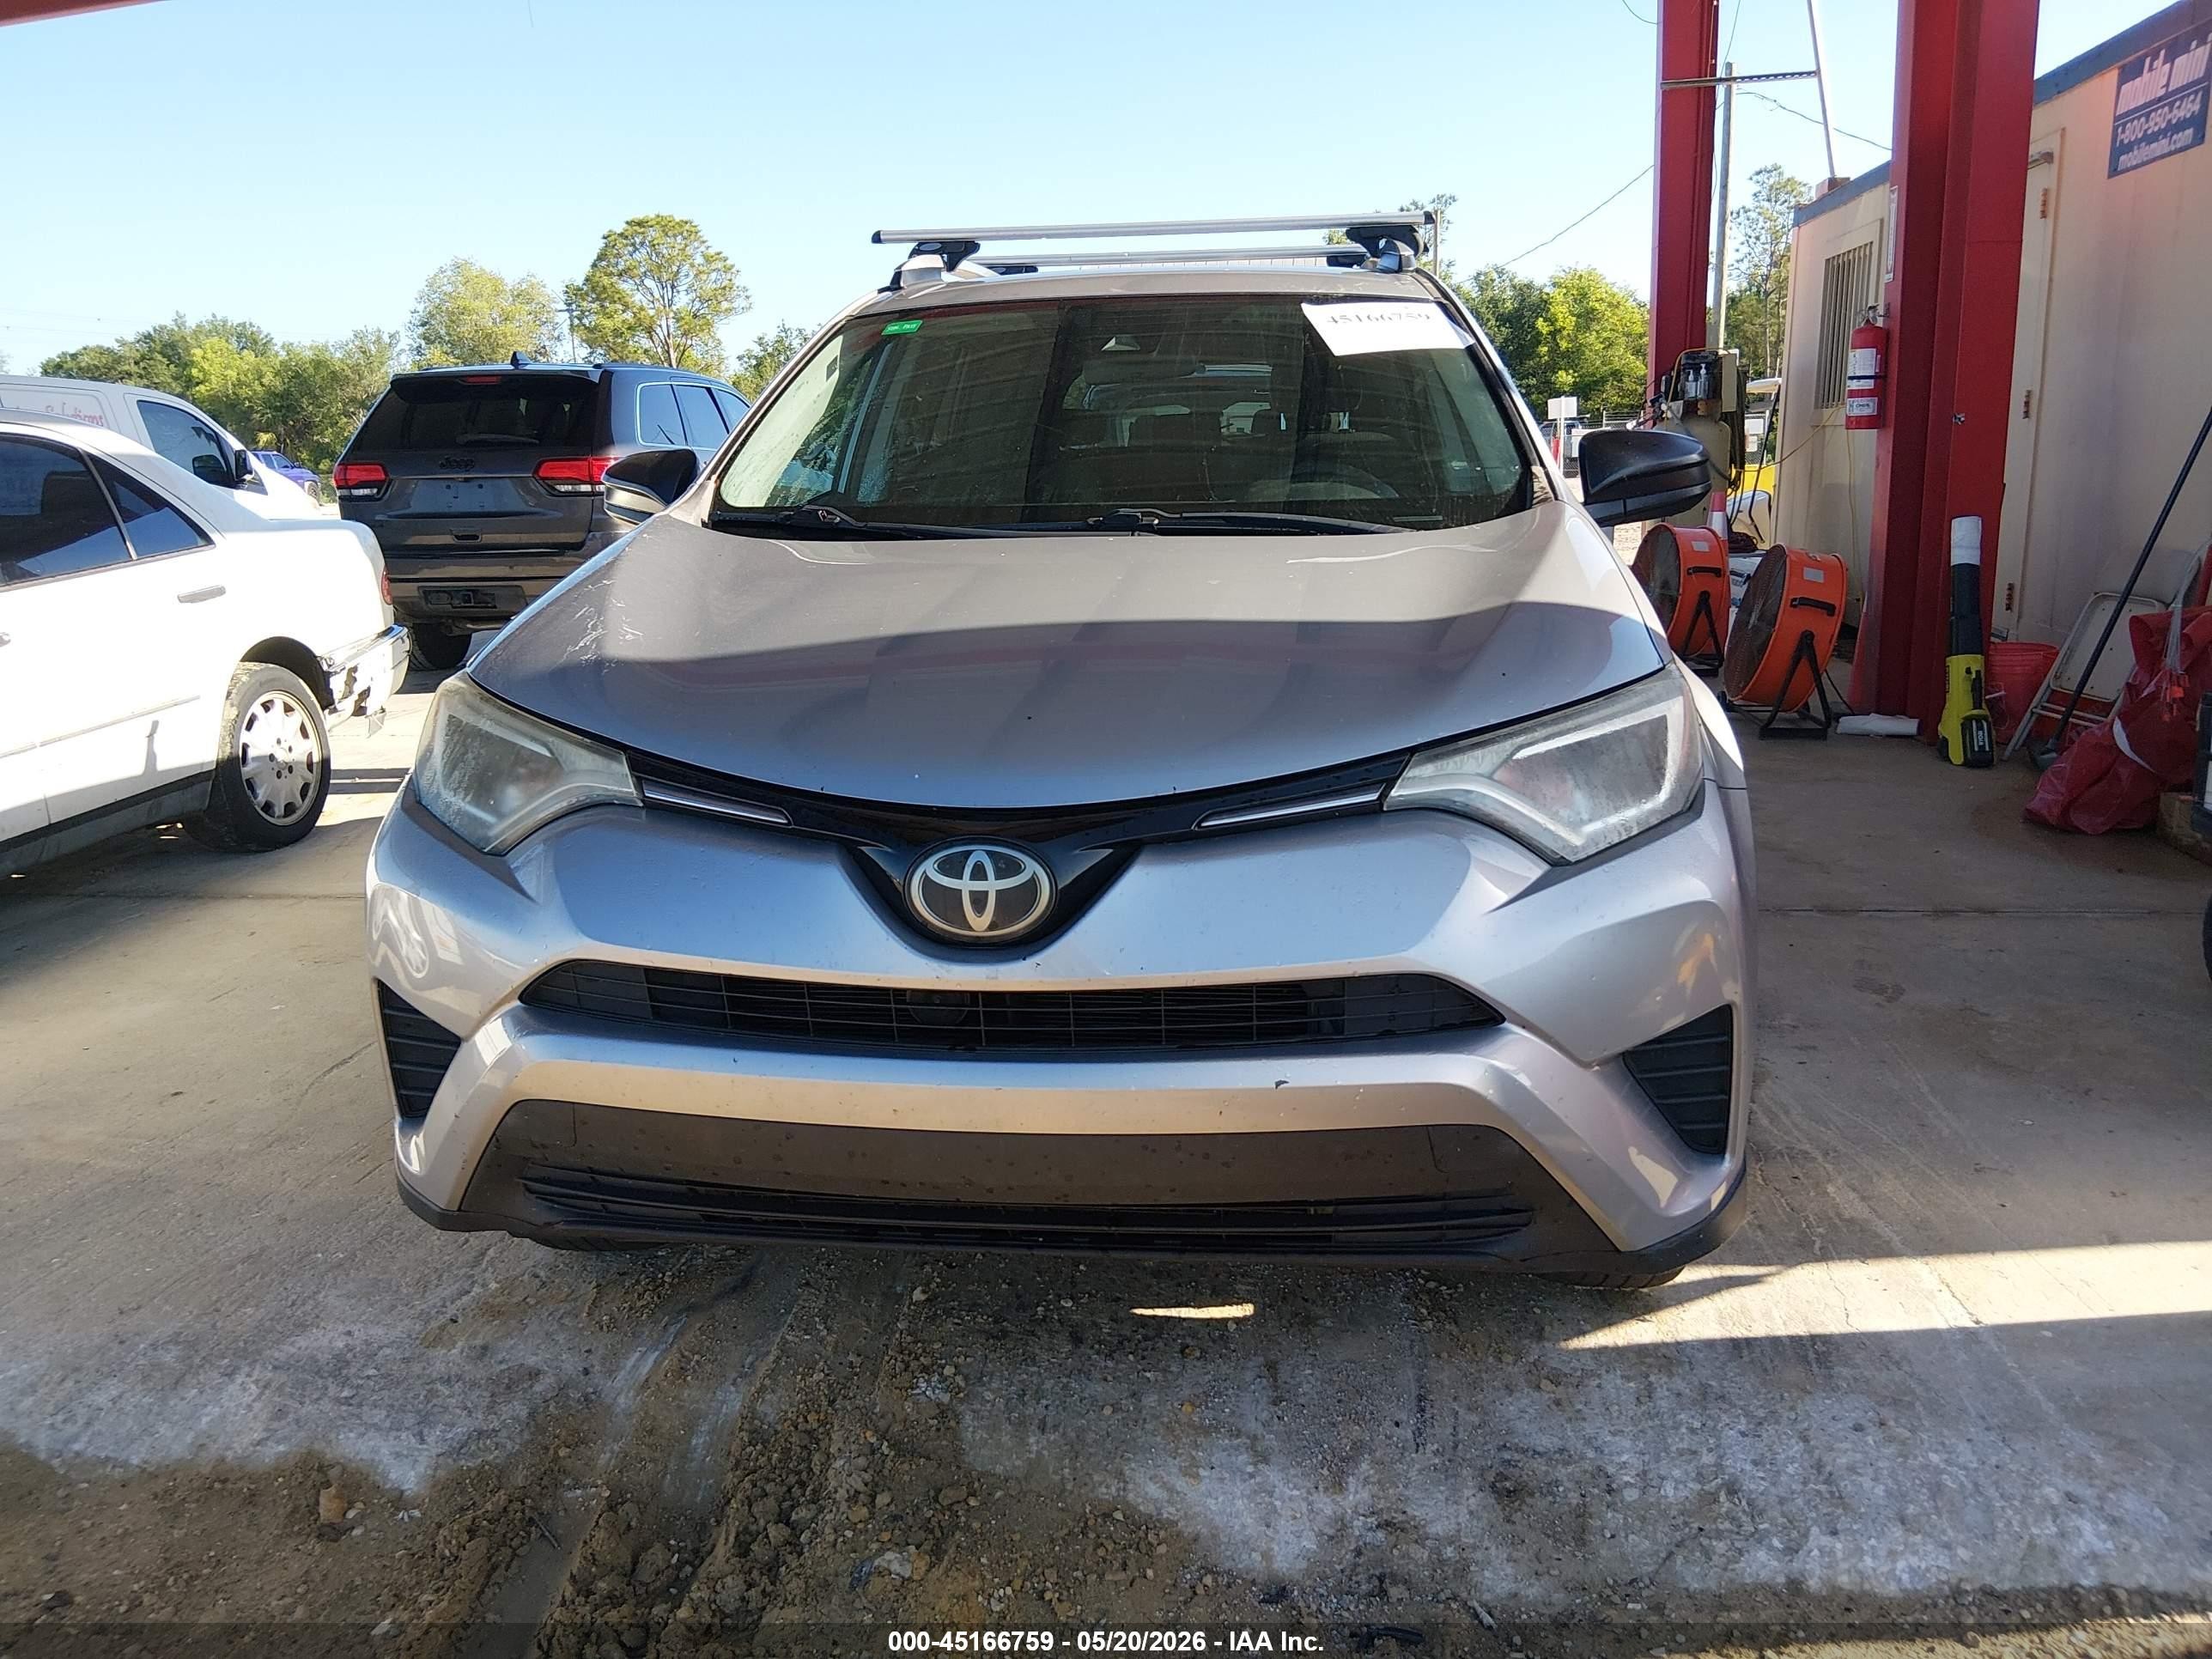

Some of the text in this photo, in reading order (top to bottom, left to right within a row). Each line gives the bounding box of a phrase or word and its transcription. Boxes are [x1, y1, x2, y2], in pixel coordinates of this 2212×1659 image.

[2115, 33, 2212, 116] mobile mini
[2117, 127, 2194, 171] mobilemini.com
[439, 455, 475, 473] Jeep
